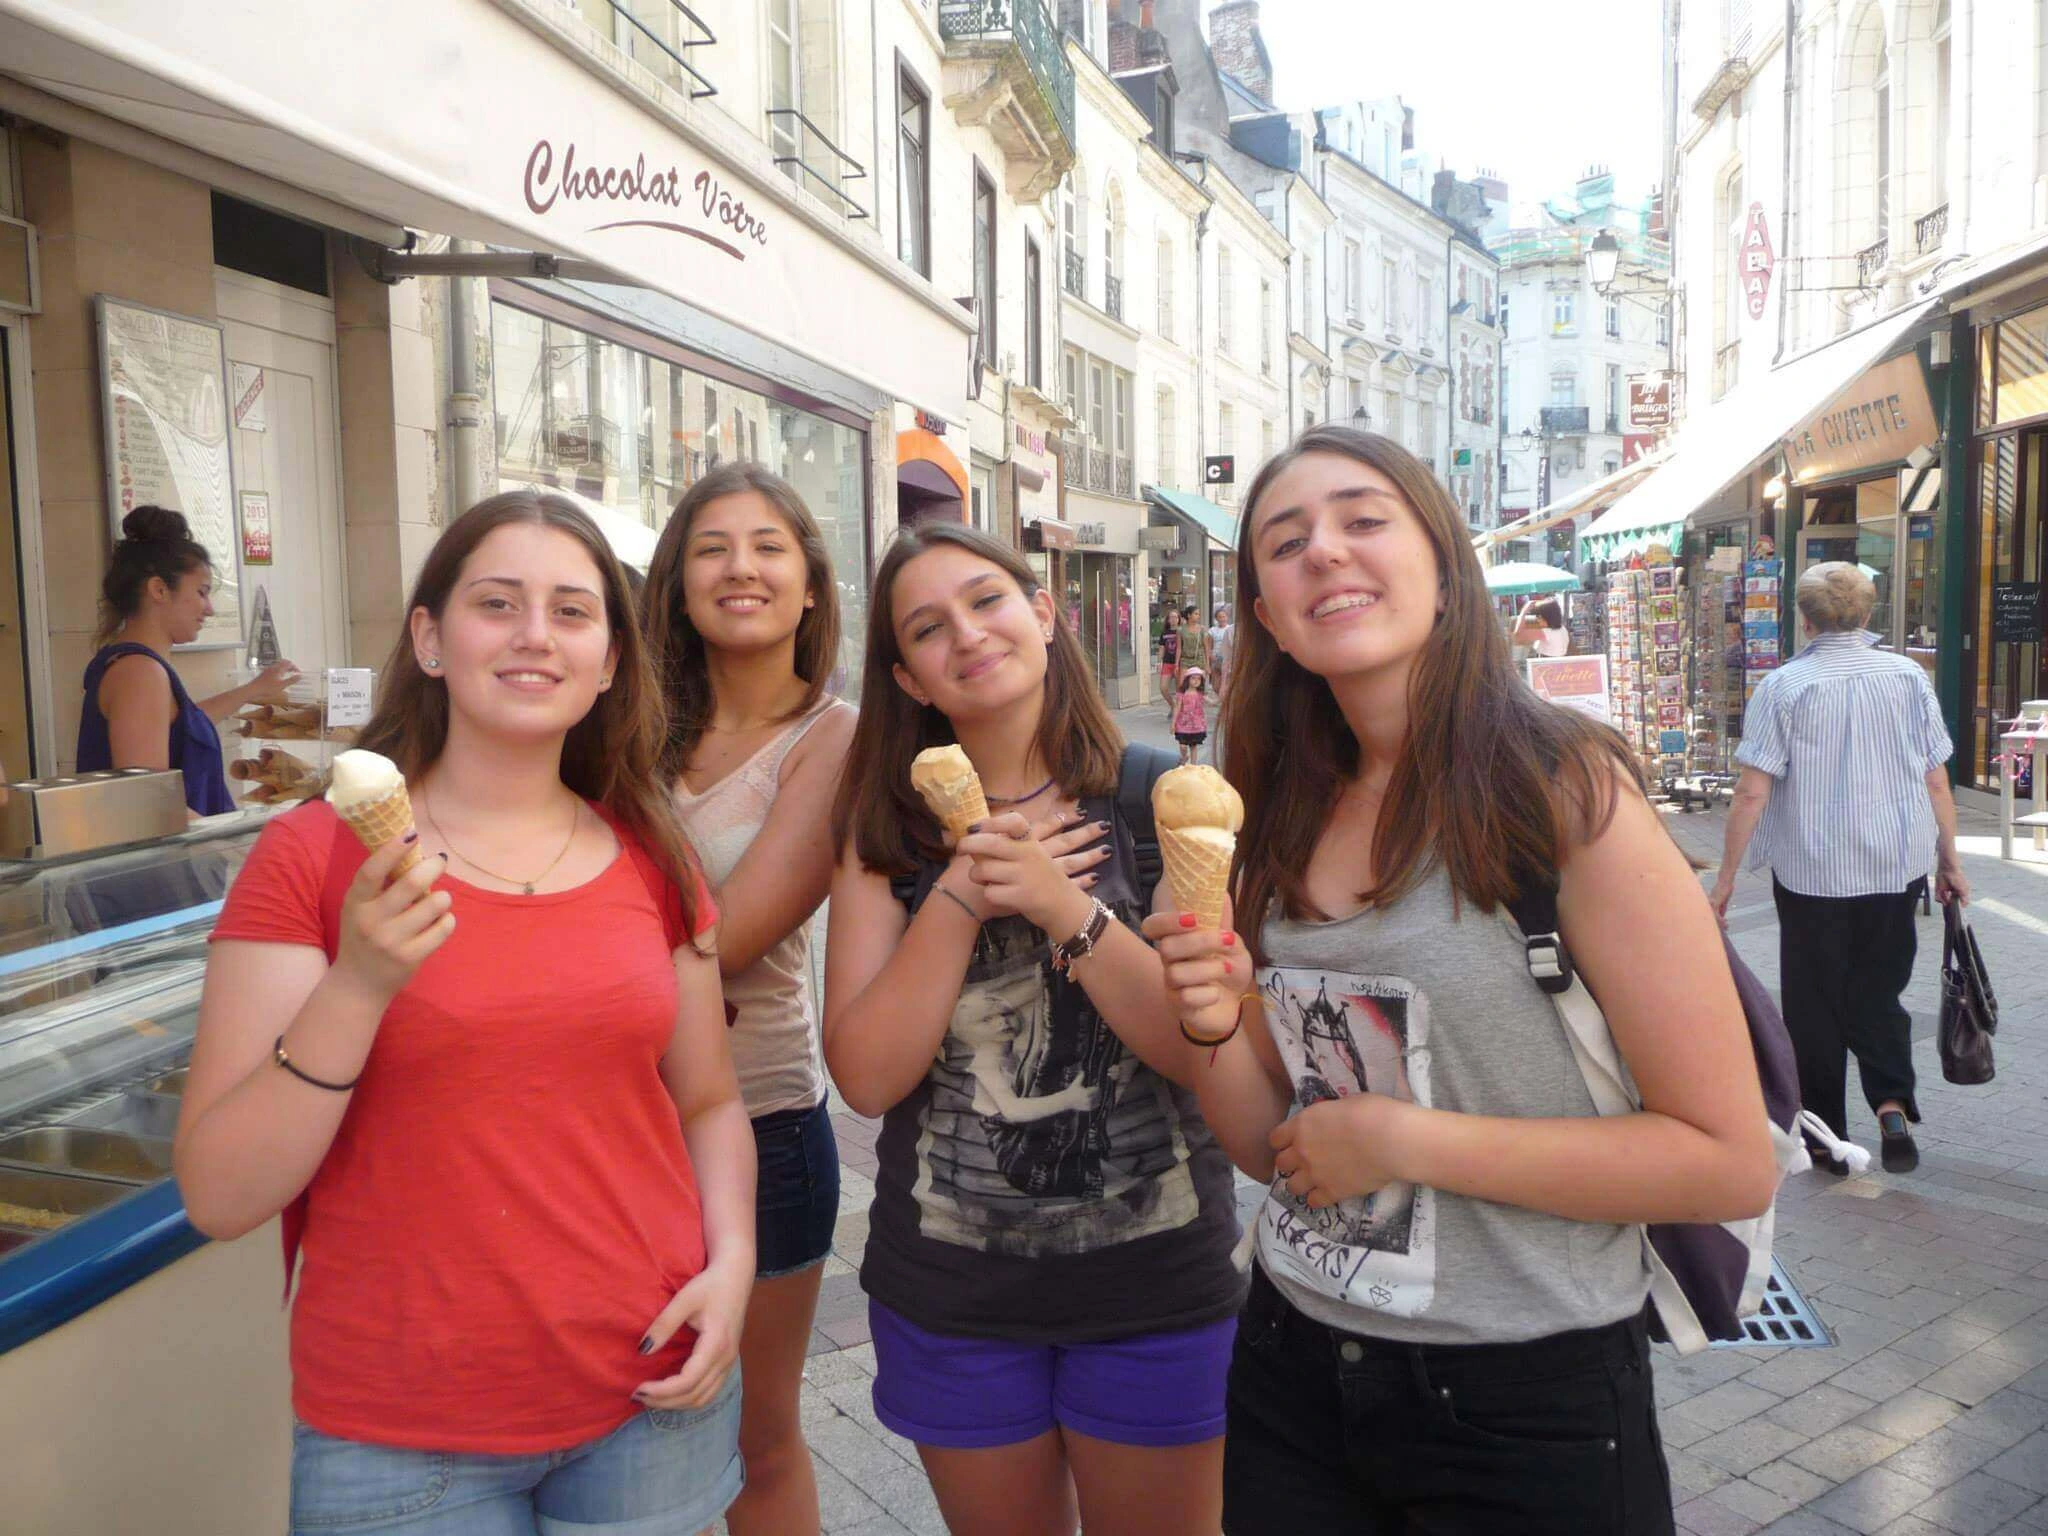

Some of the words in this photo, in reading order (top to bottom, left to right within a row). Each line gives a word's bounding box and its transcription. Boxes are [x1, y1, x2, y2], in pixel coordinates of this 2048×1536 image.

[524, 139, 681, 215] Chocolat
[694, 170, 768, 246] Vôtre
[1746, 208, 1768, 314] TABAC
